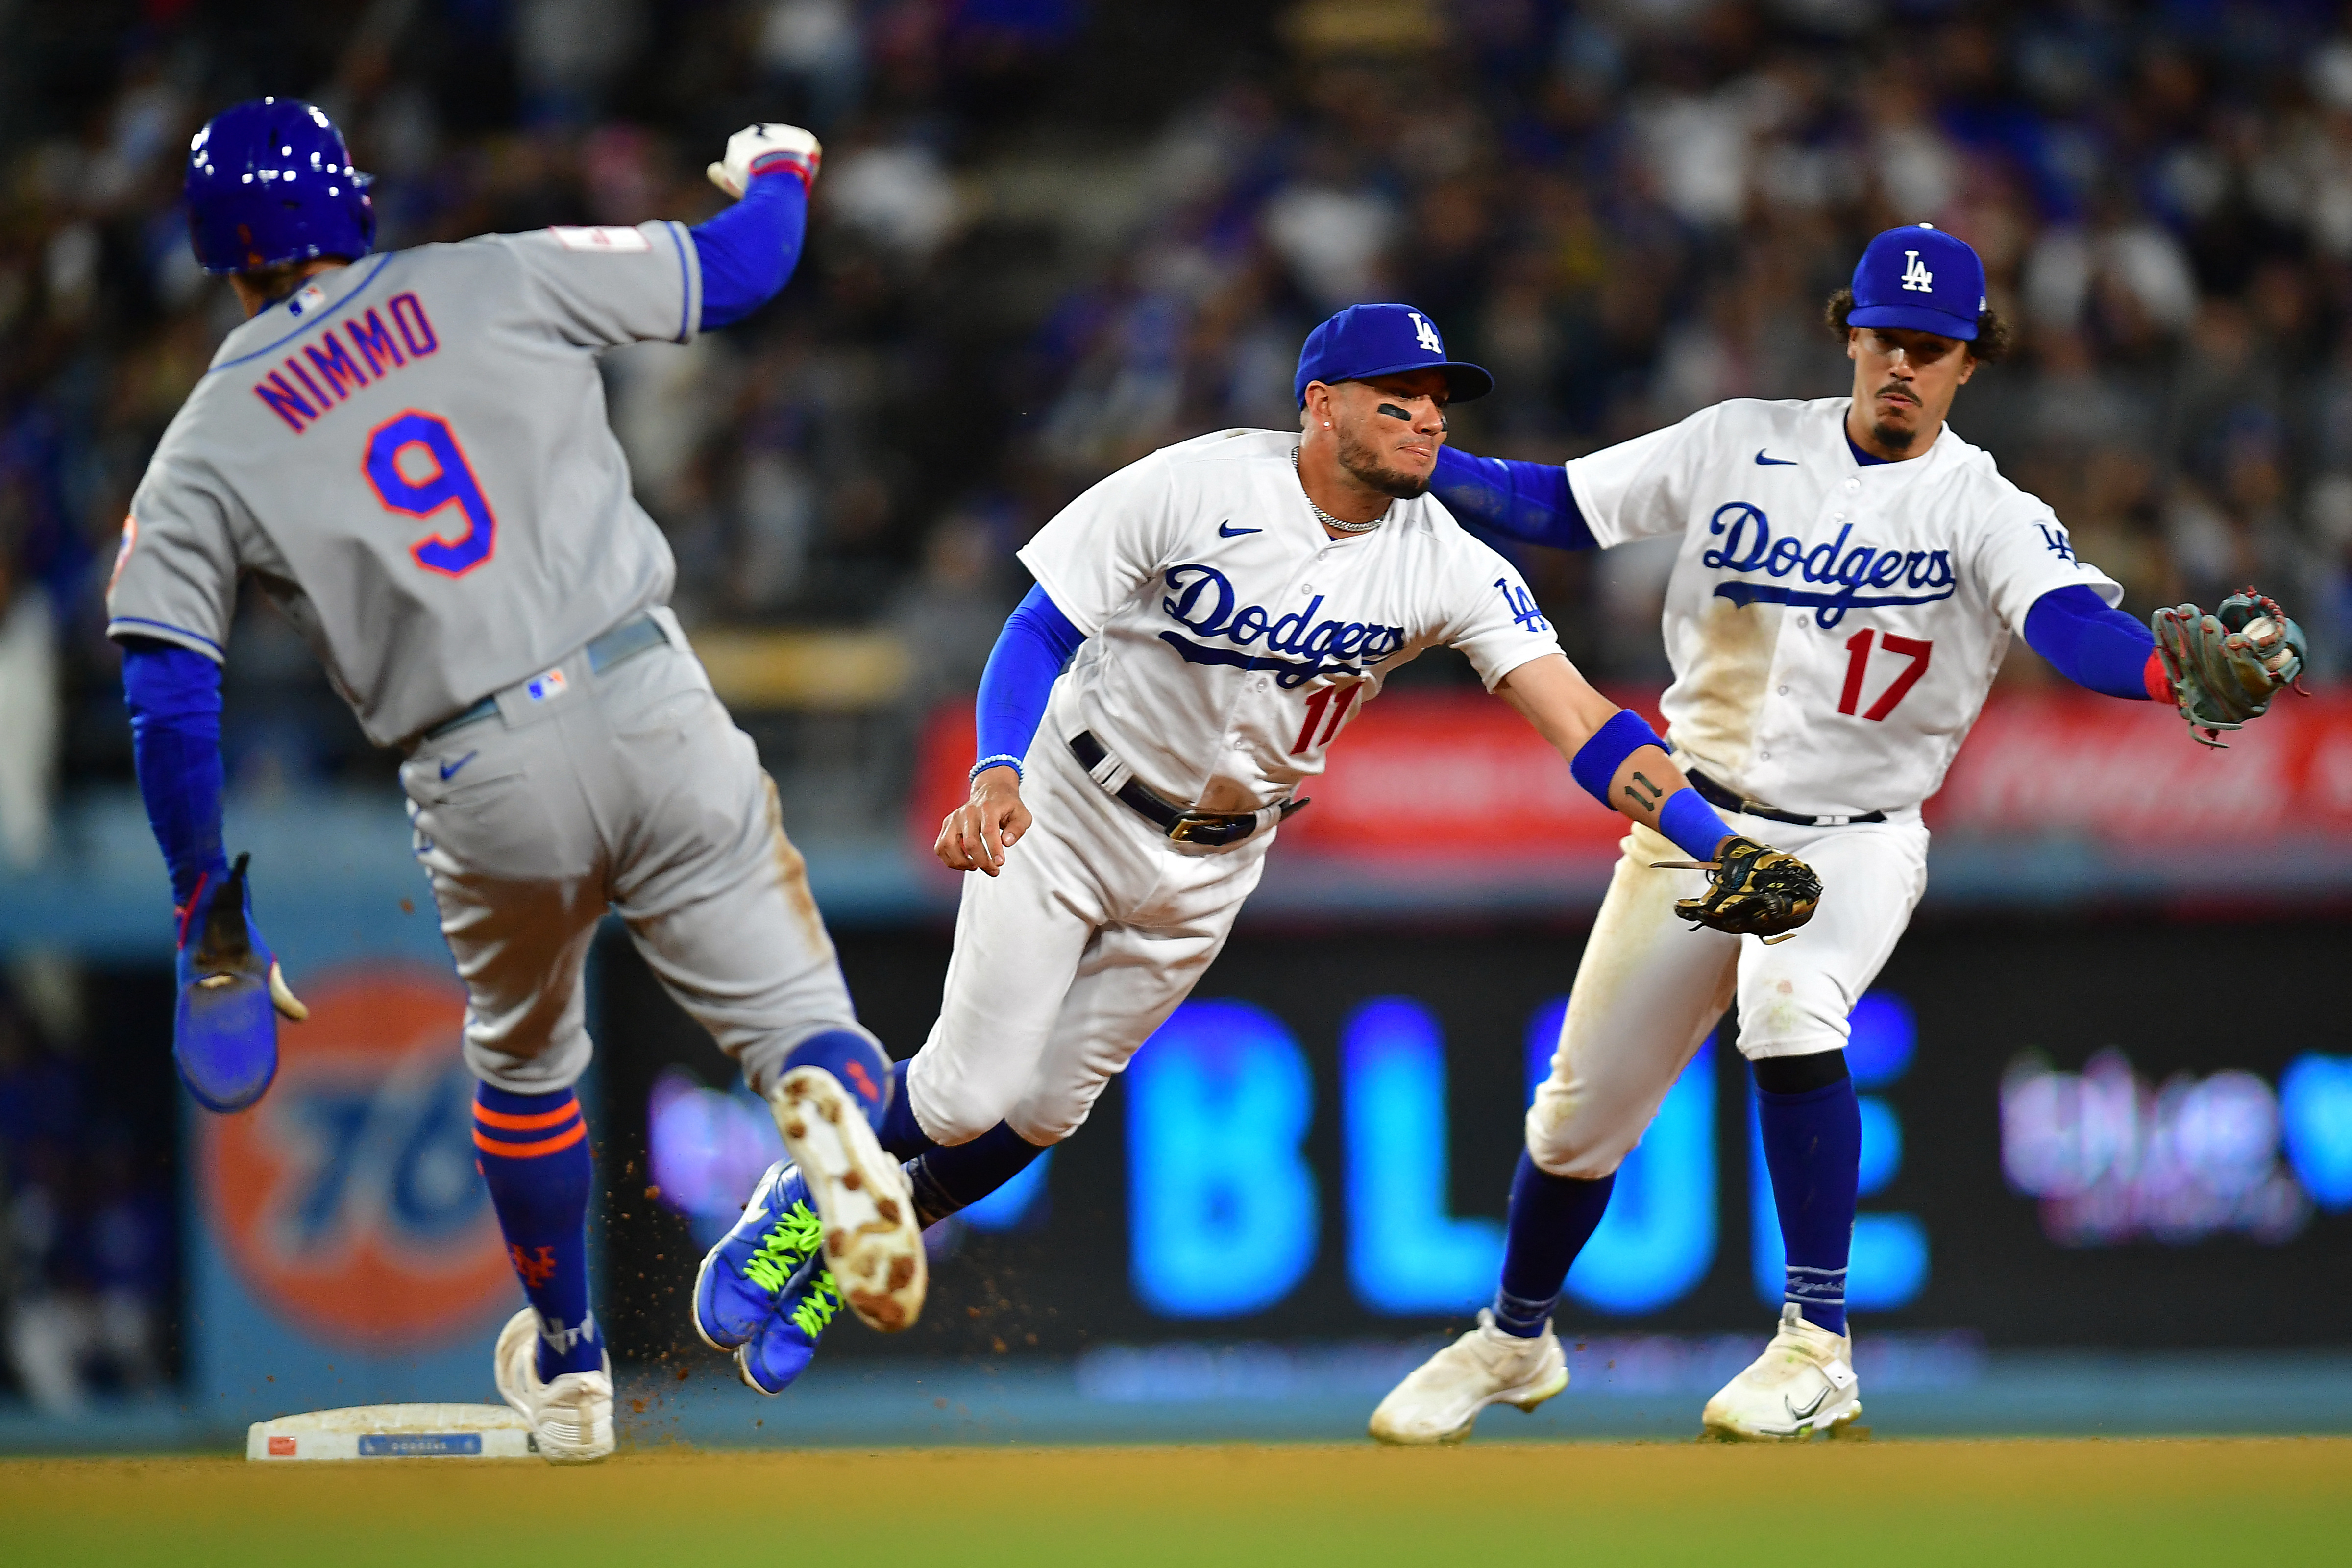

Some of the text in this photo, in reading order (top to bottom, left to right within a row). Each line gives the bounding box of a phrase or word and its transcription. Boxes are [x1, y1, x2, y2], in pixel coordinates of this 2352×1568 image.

[1901, 250, 1933, 293] LA
[253, 291, 440, 434] NIMMO
[1408, 313, 1442, 354] LA
[360, 407, 497, 579] 9
[1493, 577, 1549, 633] LA
[1703, 500, 1957, 629] Dodgers
[1163, 564, 1405, 689] Dodgers
[1291, 681, 1364, 755] 11
[1838, 627, 1933, 722] 17
[1624, 771, 1663, 812] 11
[277, 1049, 490, 1254] 76
